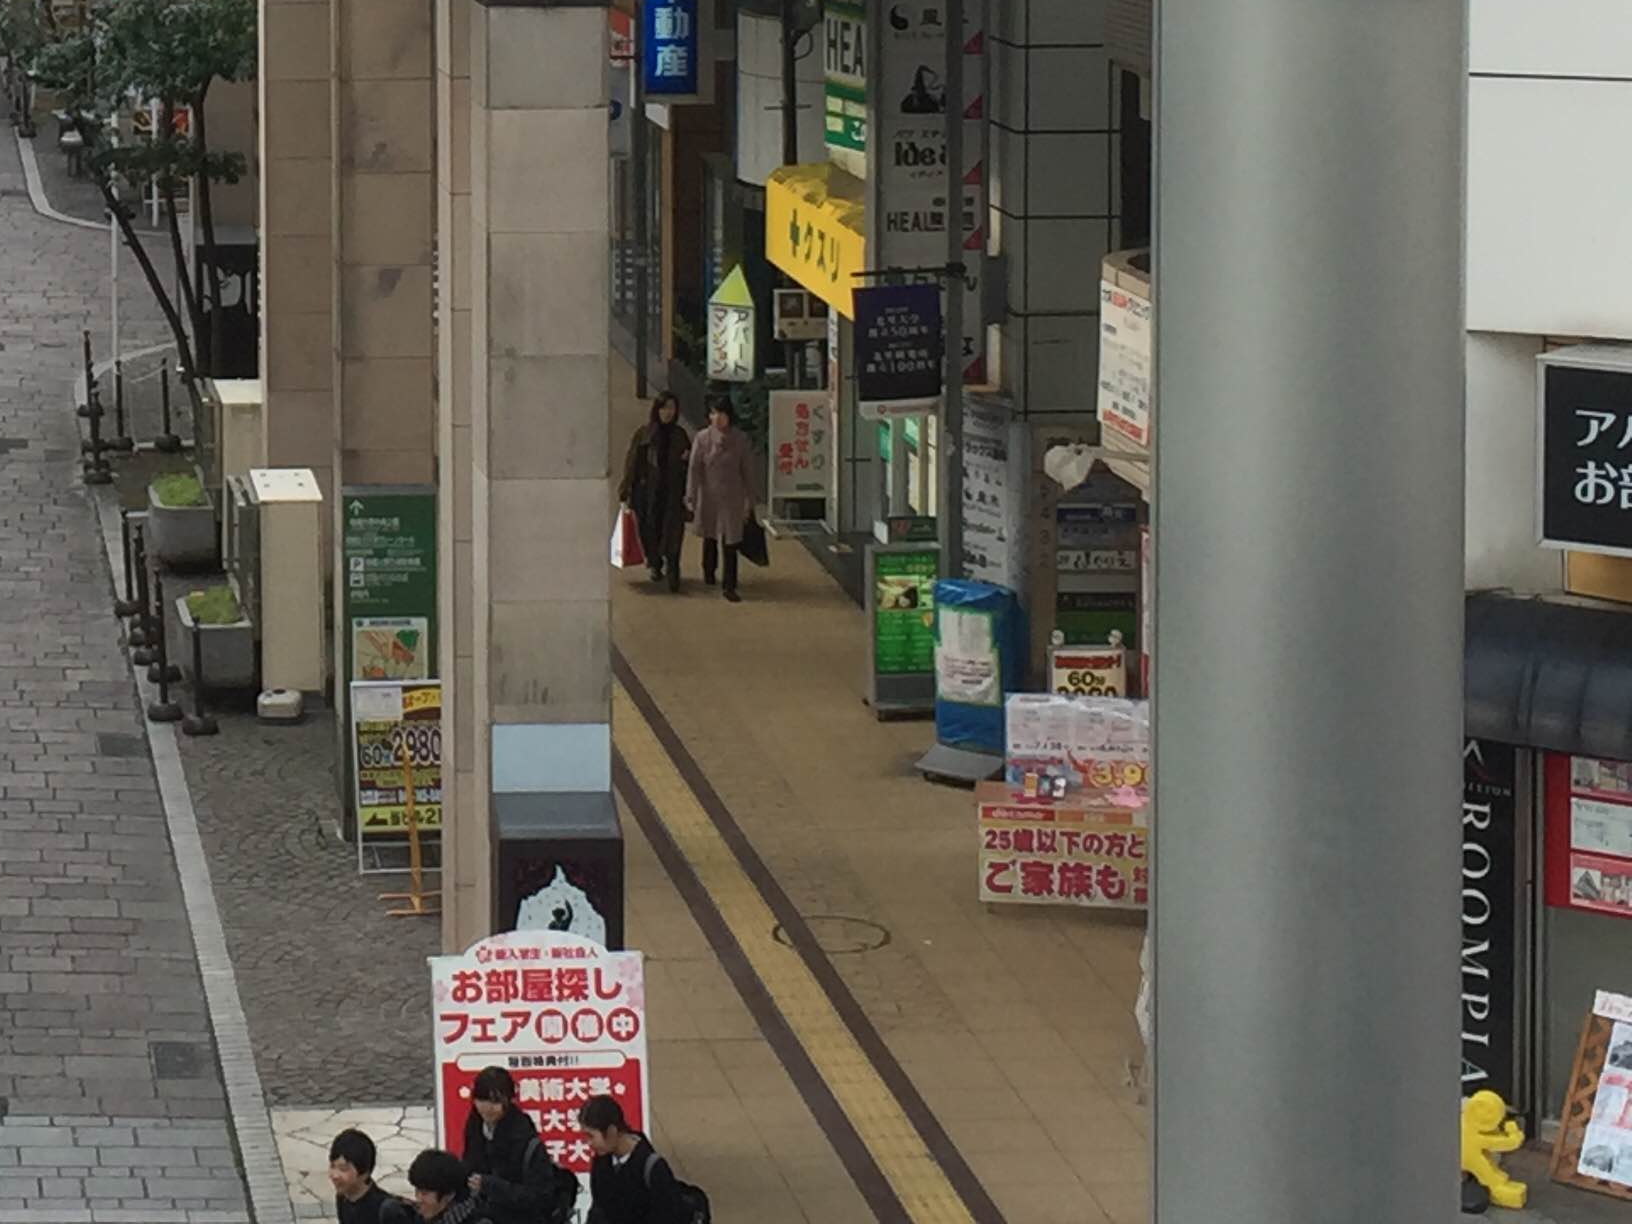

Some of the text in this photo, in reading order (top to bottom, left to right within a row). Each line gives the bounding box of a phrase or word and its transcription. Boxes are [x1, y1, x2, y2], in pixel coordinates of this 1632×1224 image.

[733, 308, 749, 375] アパート
[984, 828, 1144, 859] 25歳以下の方と
[985, 859, 1126, 901] ご家族も
[451, 967, 623, 1004] お部屋探し
[514, 1076, 612, 1102] 美術大学
